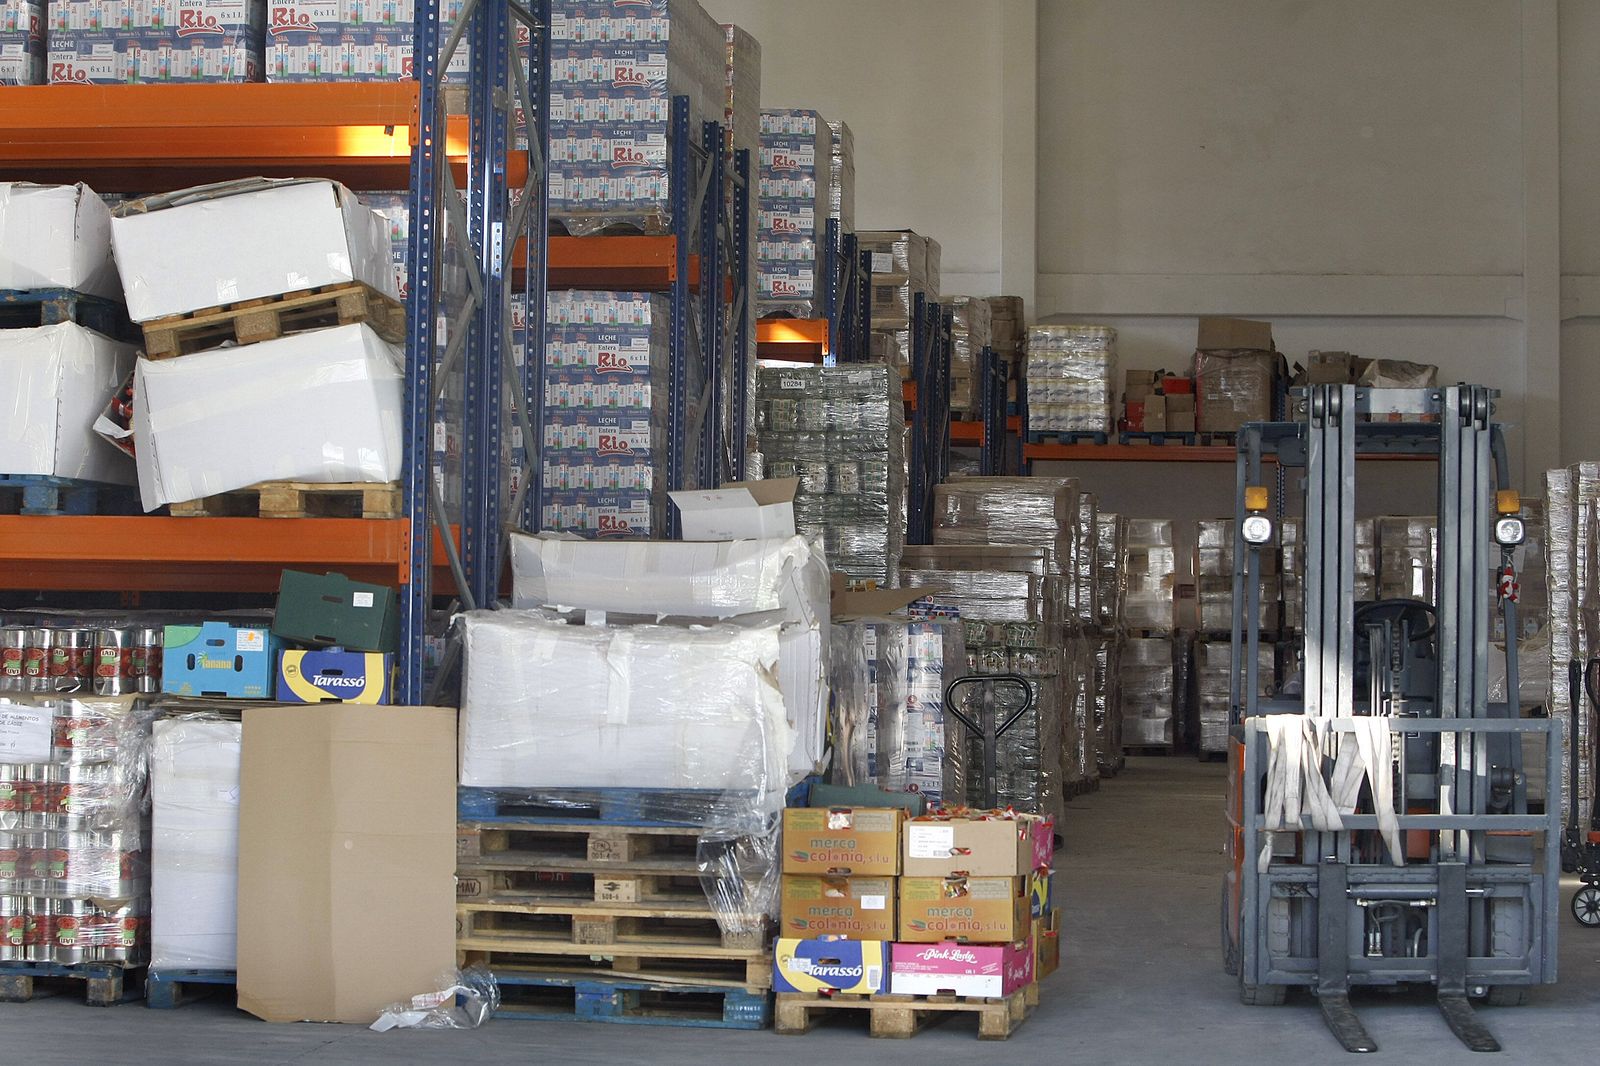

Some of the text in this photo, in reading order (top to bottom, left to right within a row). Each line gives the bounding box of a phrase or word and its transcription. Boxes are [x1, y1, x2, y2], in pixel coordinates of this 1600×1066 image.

[180, 9, 217, 28] Rio
[273, 7, 310, 26] Rio
[52, 40, 74, 48] LECHE
[401, 34, 414, 42] LEC
[52, 63, 86, 81] Rio
[614, 67, 645, 82] Rio
[613, 147, 644, 162] Rio
[773, 155, 797, 167] Rio
[773, 218, 797, 230] Rio
[772, 280, 796, 292] Rio
[597, 352, 627, 367] Rio
[598, 435, 628, 450] Rio
[598, 515, 628, 530] Rio
[313, 674, 365, 688] Tarassó
[810, 838, 857, 849] merca
[808, 906, 854, 917] merca
[927, 906, 972, 917] merca
[916, 948, 949, 961] Pink
